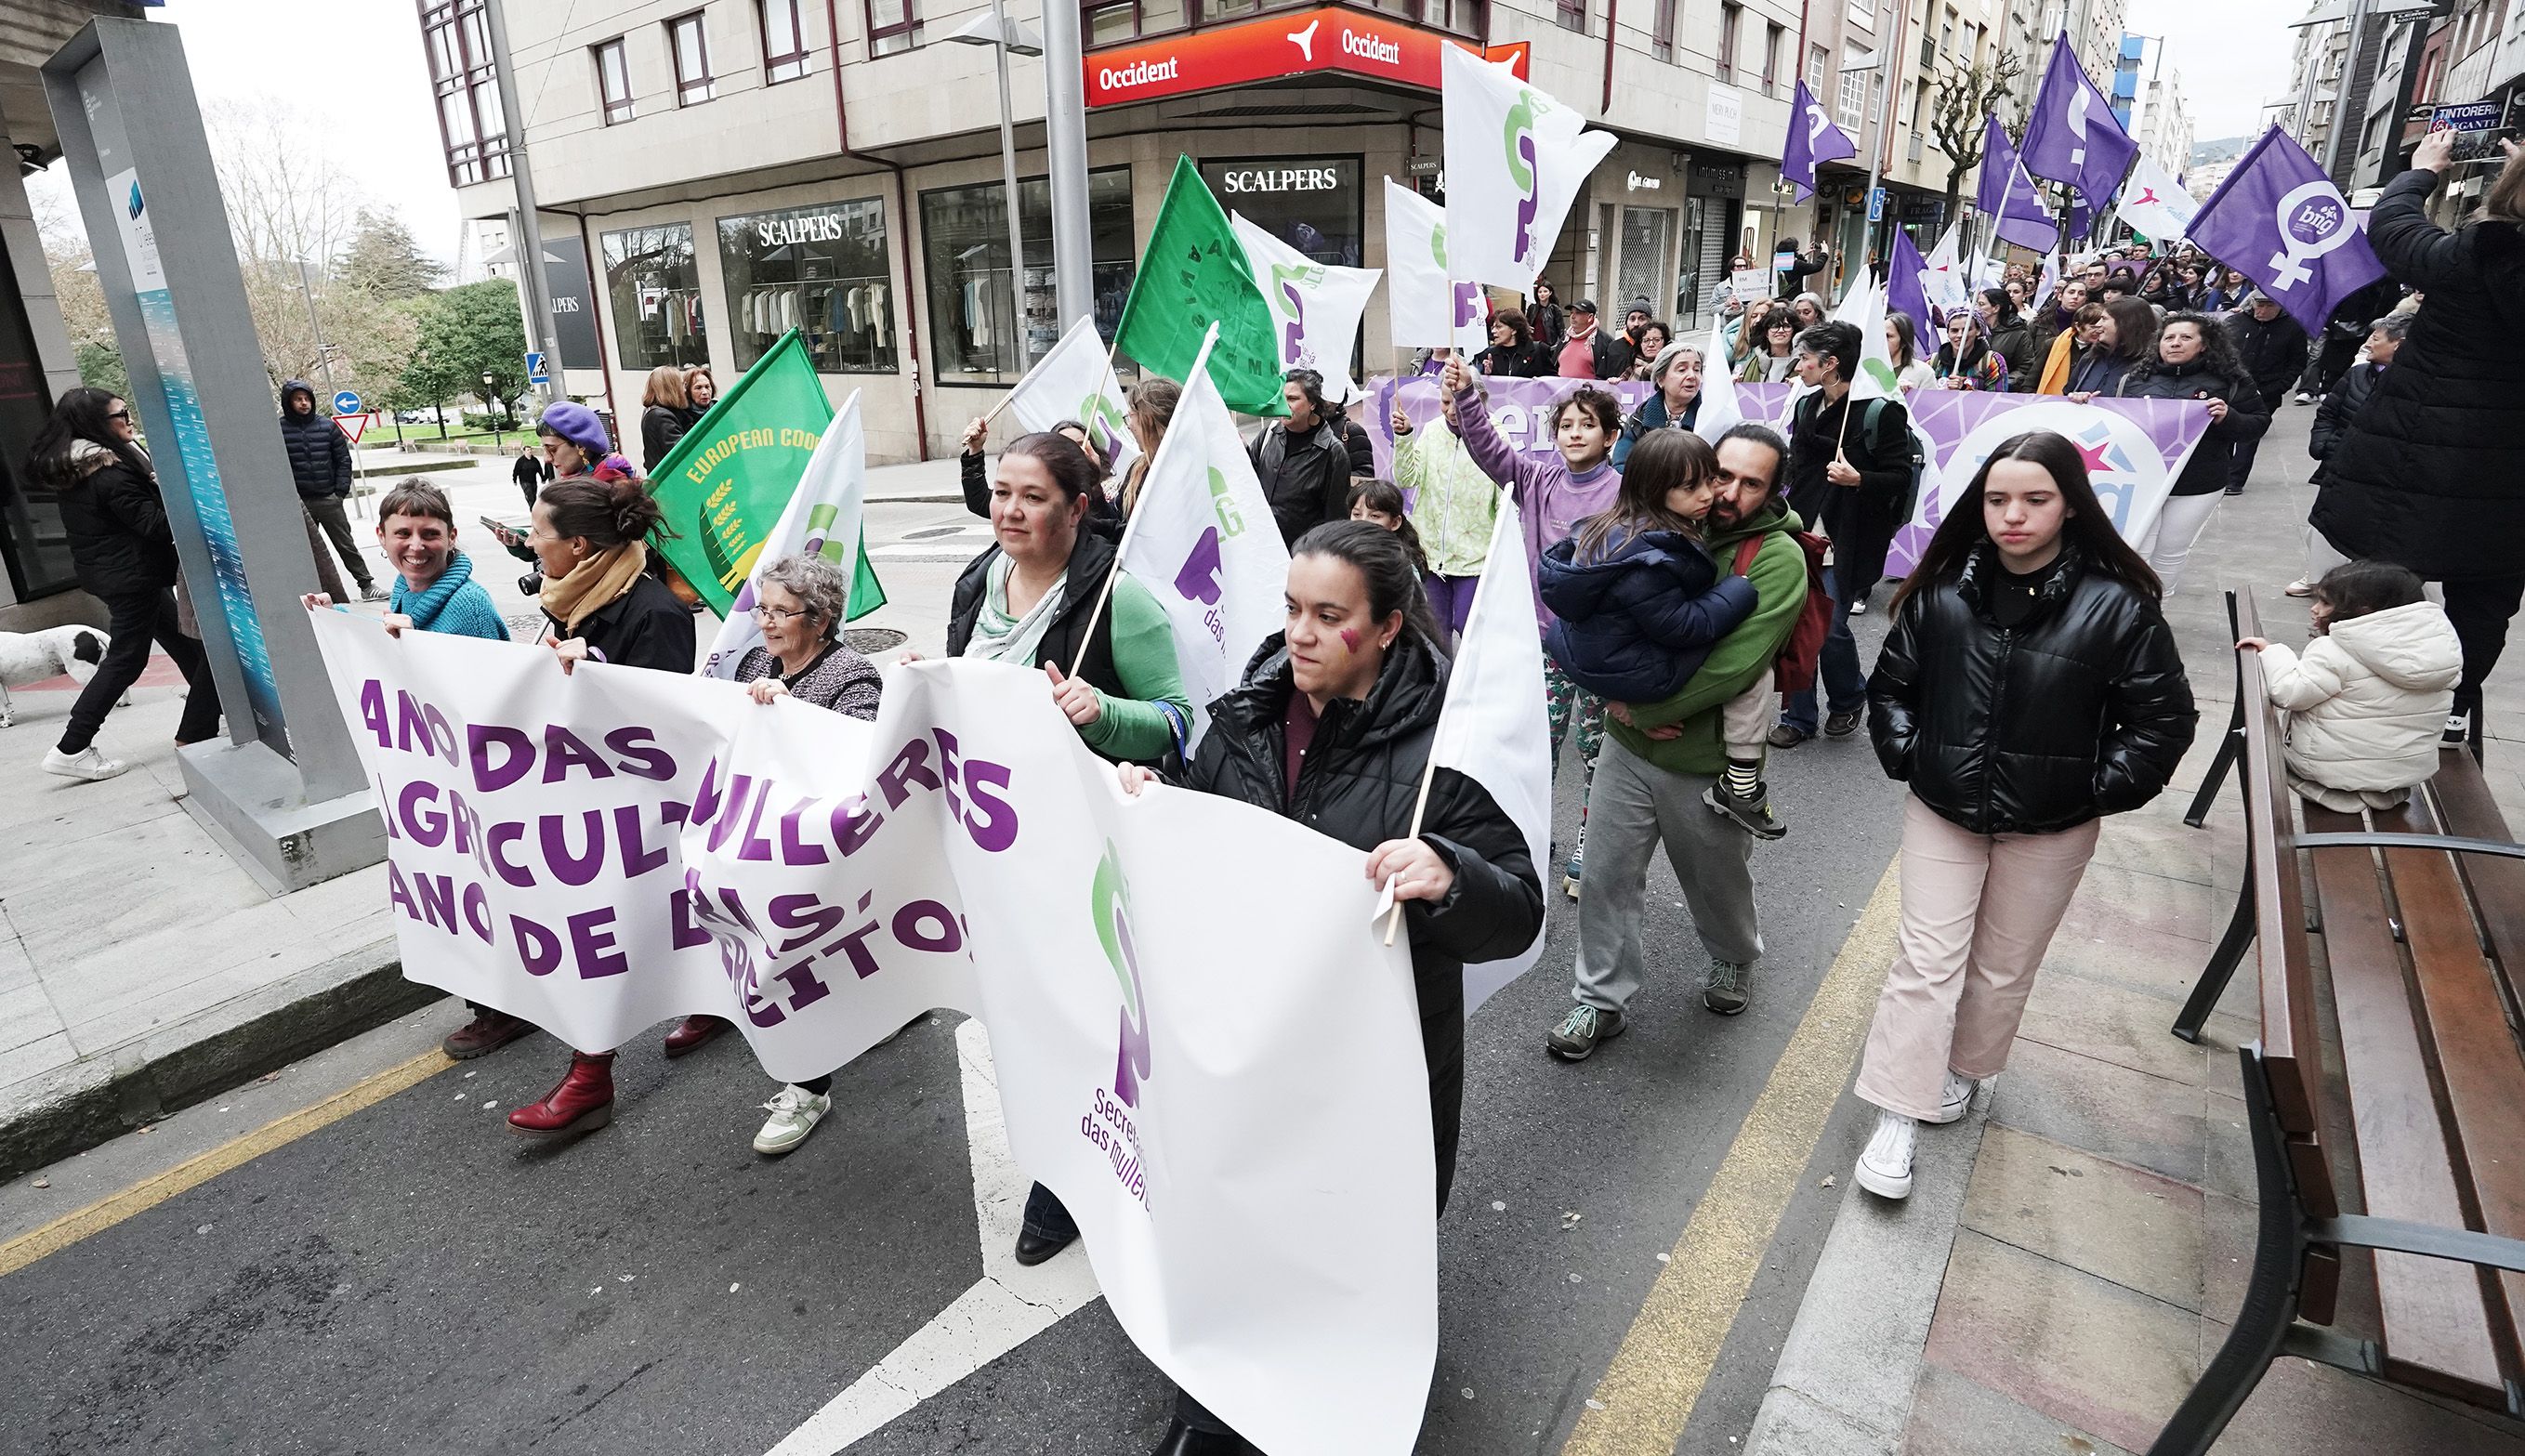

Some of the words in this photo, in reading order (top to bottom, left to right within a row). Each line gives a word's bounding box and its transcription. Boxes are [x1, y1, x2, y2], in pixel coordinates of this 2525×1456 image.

[1342, 28, 1400, 65] Occident
[1099, 56, 1178, 91] Occident
[2440, 104, 2503, 120] TINTORERIA
[1224, 168, 1337, 193] SCALPERS
[1410, 163, 1437, 171] SCALPERS
[757, 213, 842, 247] SCALPERS
[2298, 204, 2335, 235] bng
[686, 427, 774, 485] EUROPEAN
[1203, 608, 1225, 642] das
[361, 678, 460, 768] ANO
[467, 723, 677, 794] DAS
[388, 858, 495, 948] ANO
[509, 905, 629, 981] DE
[1081, 1112, 1109, 1153] das
